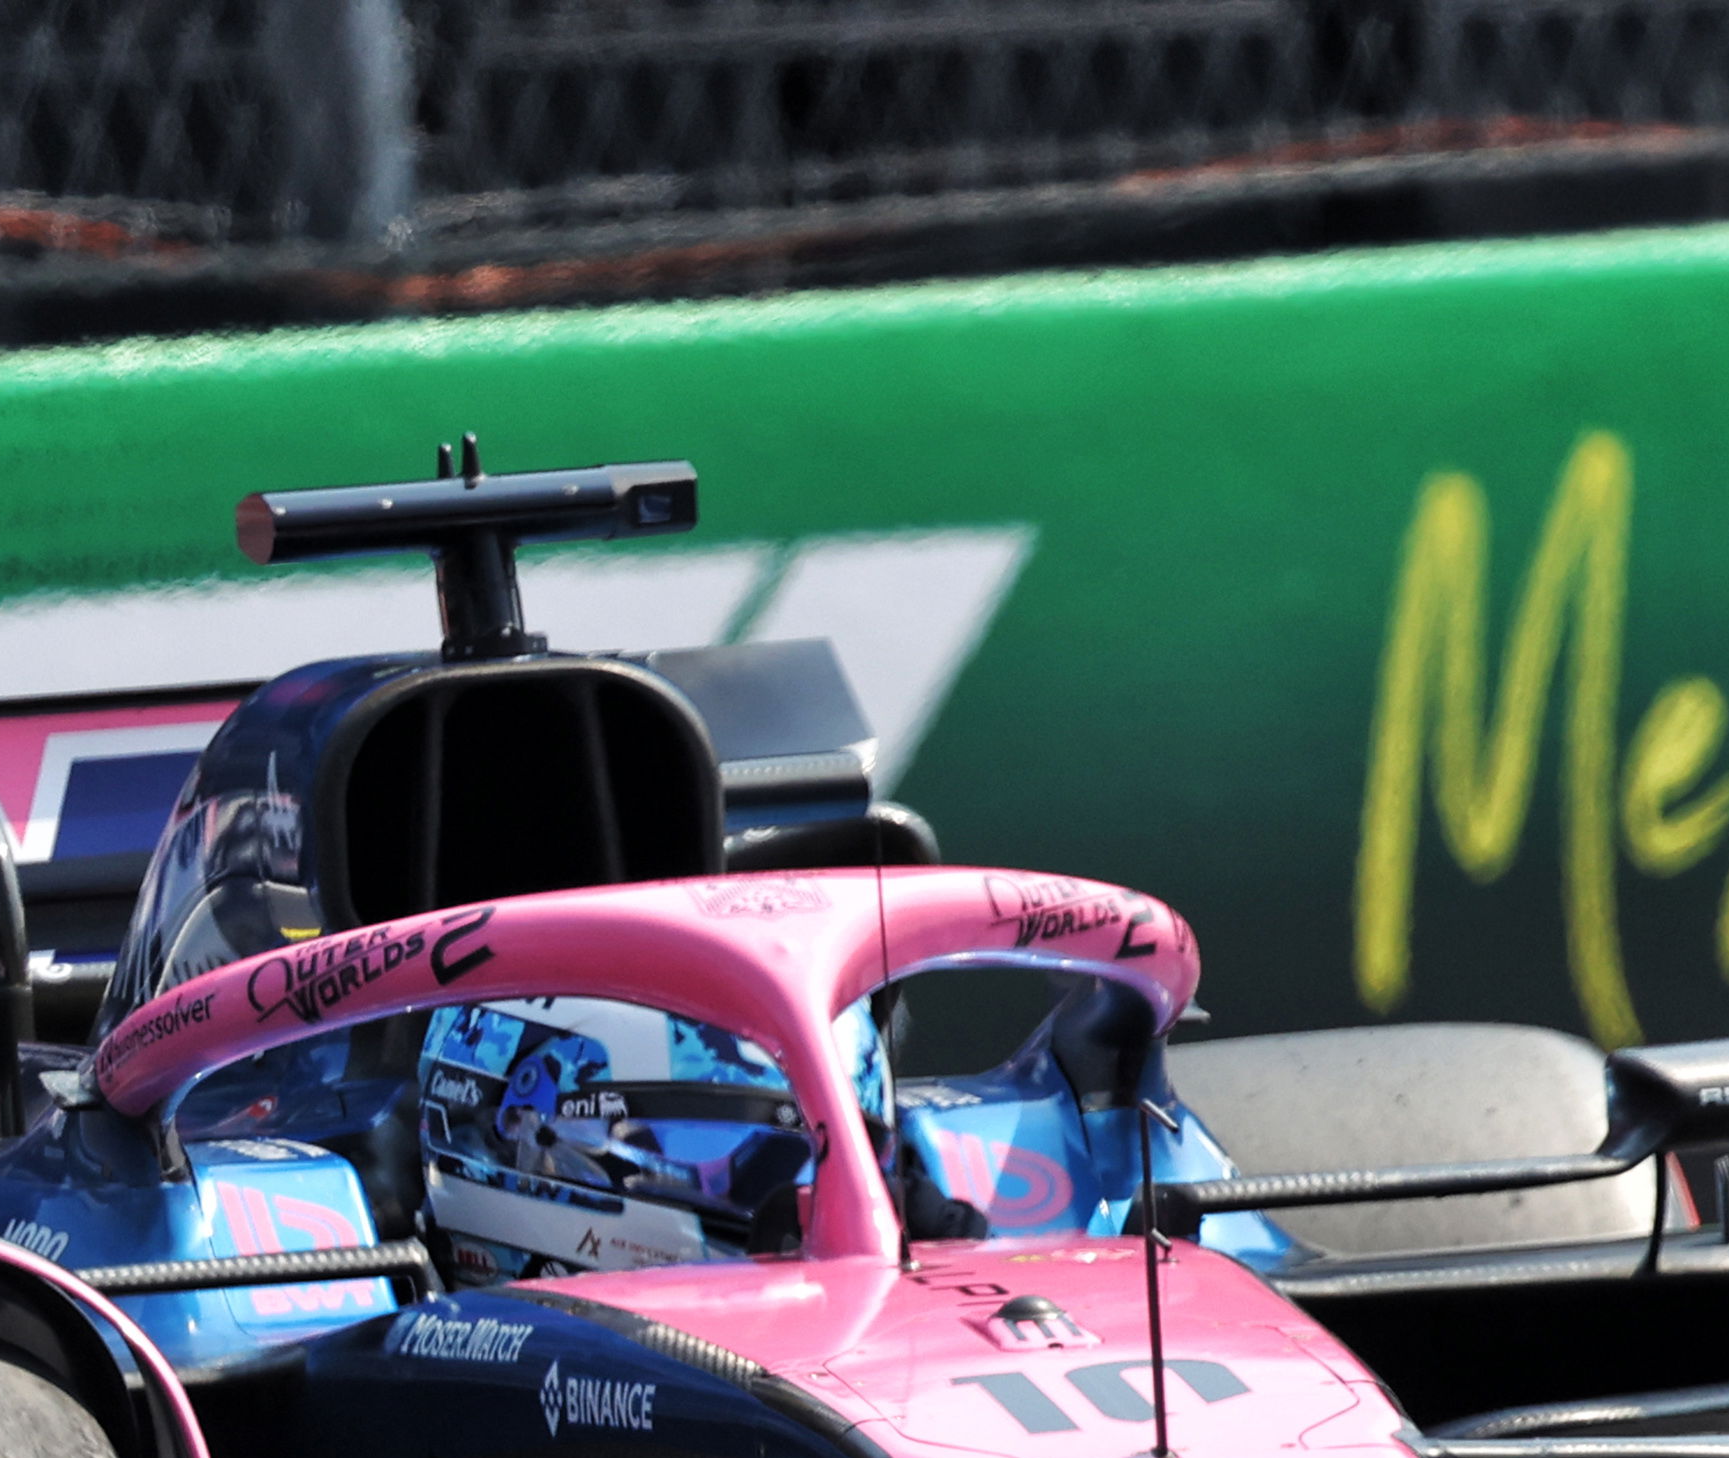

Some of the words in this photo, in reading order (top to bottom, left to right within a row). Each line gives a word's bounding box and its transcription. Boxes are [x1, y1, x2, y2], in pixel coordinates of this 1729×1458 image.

[1013, 898, 1121, 949] WORLDS
[1115, 888, 1158, 960] 2
[247, 926, 391, 1012] OUTER
[277, 931, 425, 1024] WORLDS
[431, 906, 496, 986] 2
[561, 1093, 595, 1118] eni
[566, 1377, 657, 1430] BINANCE
[950, 1358, 1252, 1434] 10
